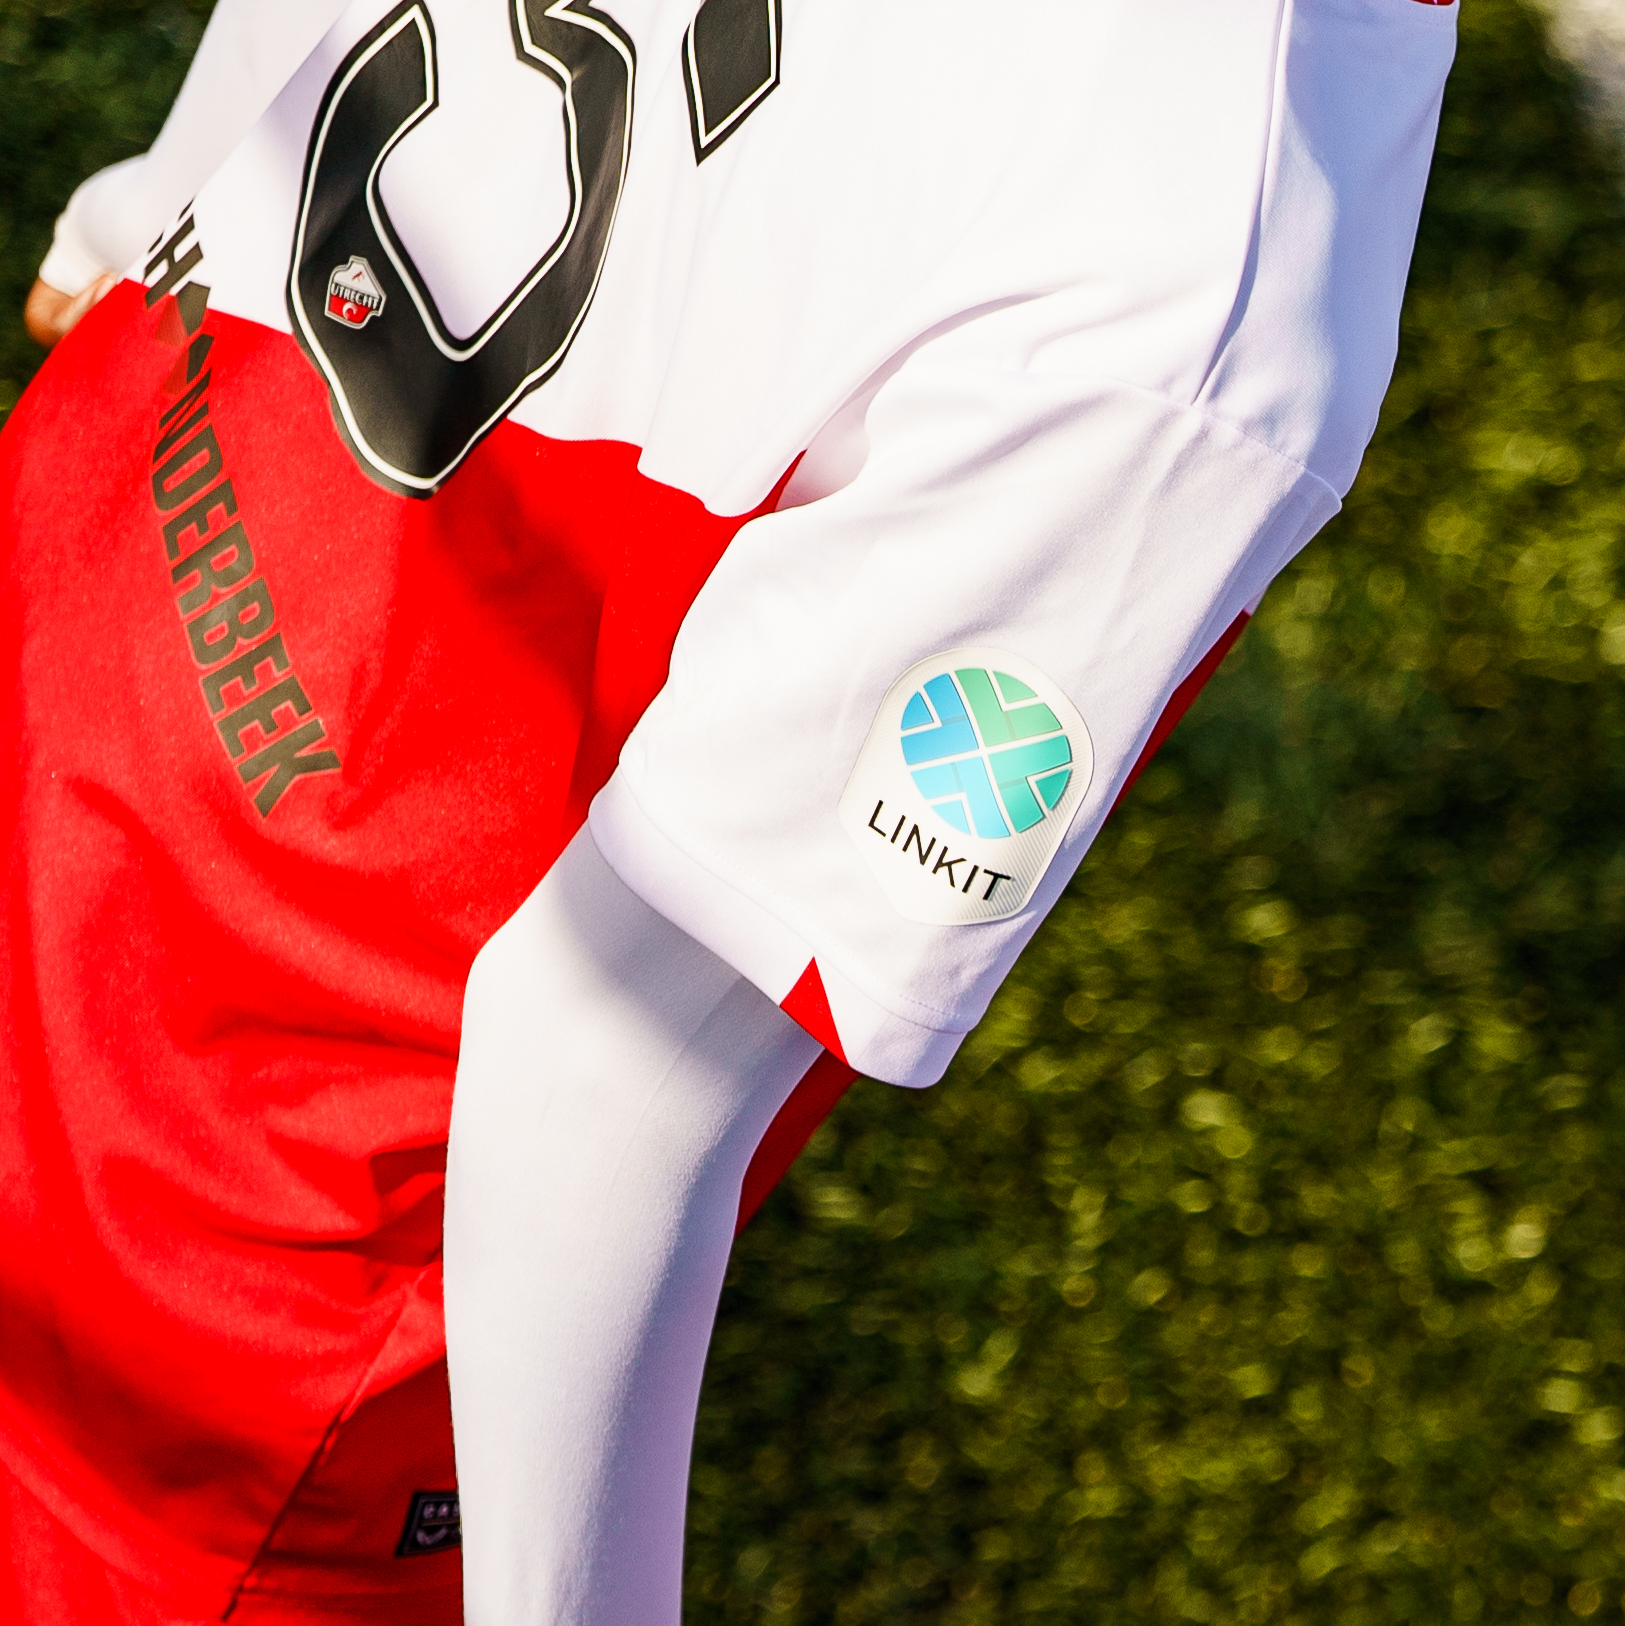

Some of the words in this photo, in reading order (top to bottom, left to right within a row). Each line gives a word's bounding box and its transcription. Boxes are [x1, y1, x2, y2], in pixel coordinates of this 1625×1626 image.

[330, 282, 380, 310] UTRECHT
[142, 196, 342, 819] HOONDERBEEK
[867, 799, 1013, 901] LINKIT
